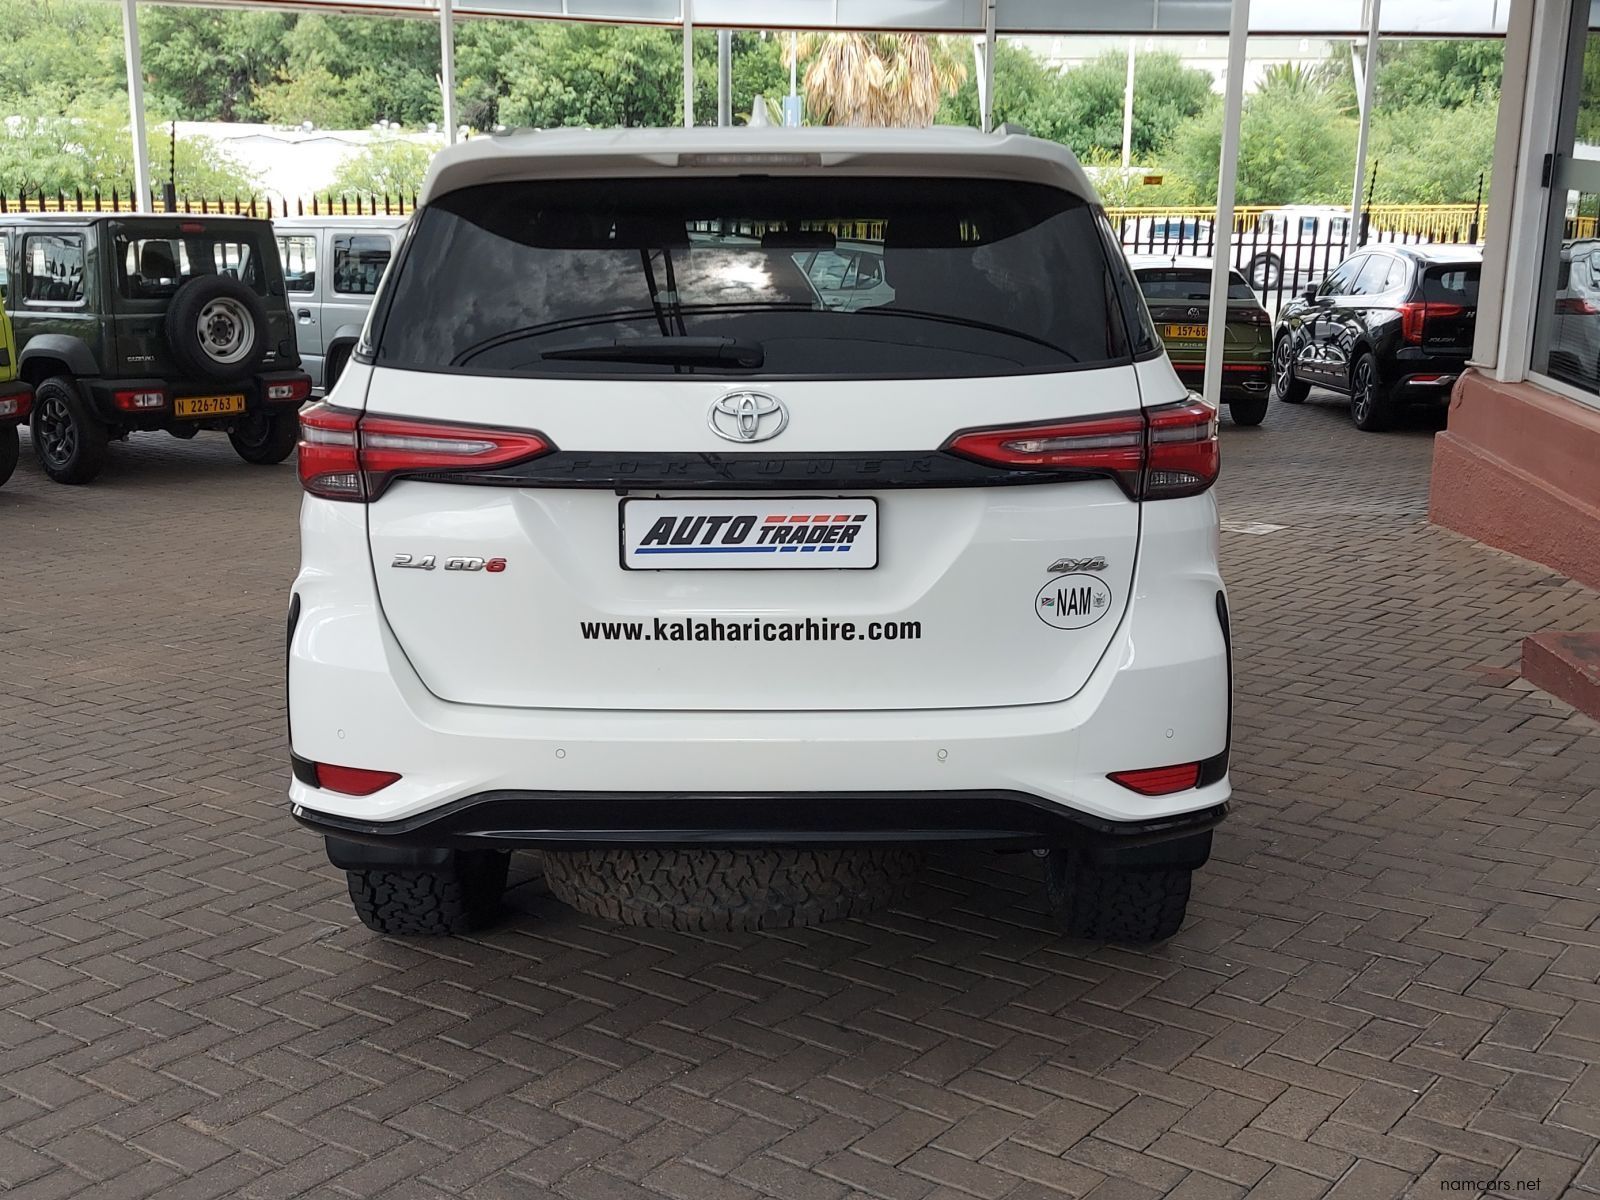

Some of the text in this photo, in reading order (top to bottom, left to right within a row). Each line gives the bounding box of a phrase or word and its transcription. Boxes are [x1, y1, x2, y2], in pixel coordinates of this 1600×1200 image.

[1166, 326, 1208, 337] N 157-68
[177, 396, 243, 415] N 226-763 W
[567, 459, 932, 475] FORTUNER
[640, 516, 862, 546] AUTO TRADER
[444, 556, 507, 572] GD-6
[1056, 586, 1092, 617] NAM
[580, 618, 921, 642] www.kalaharicarhire.com
